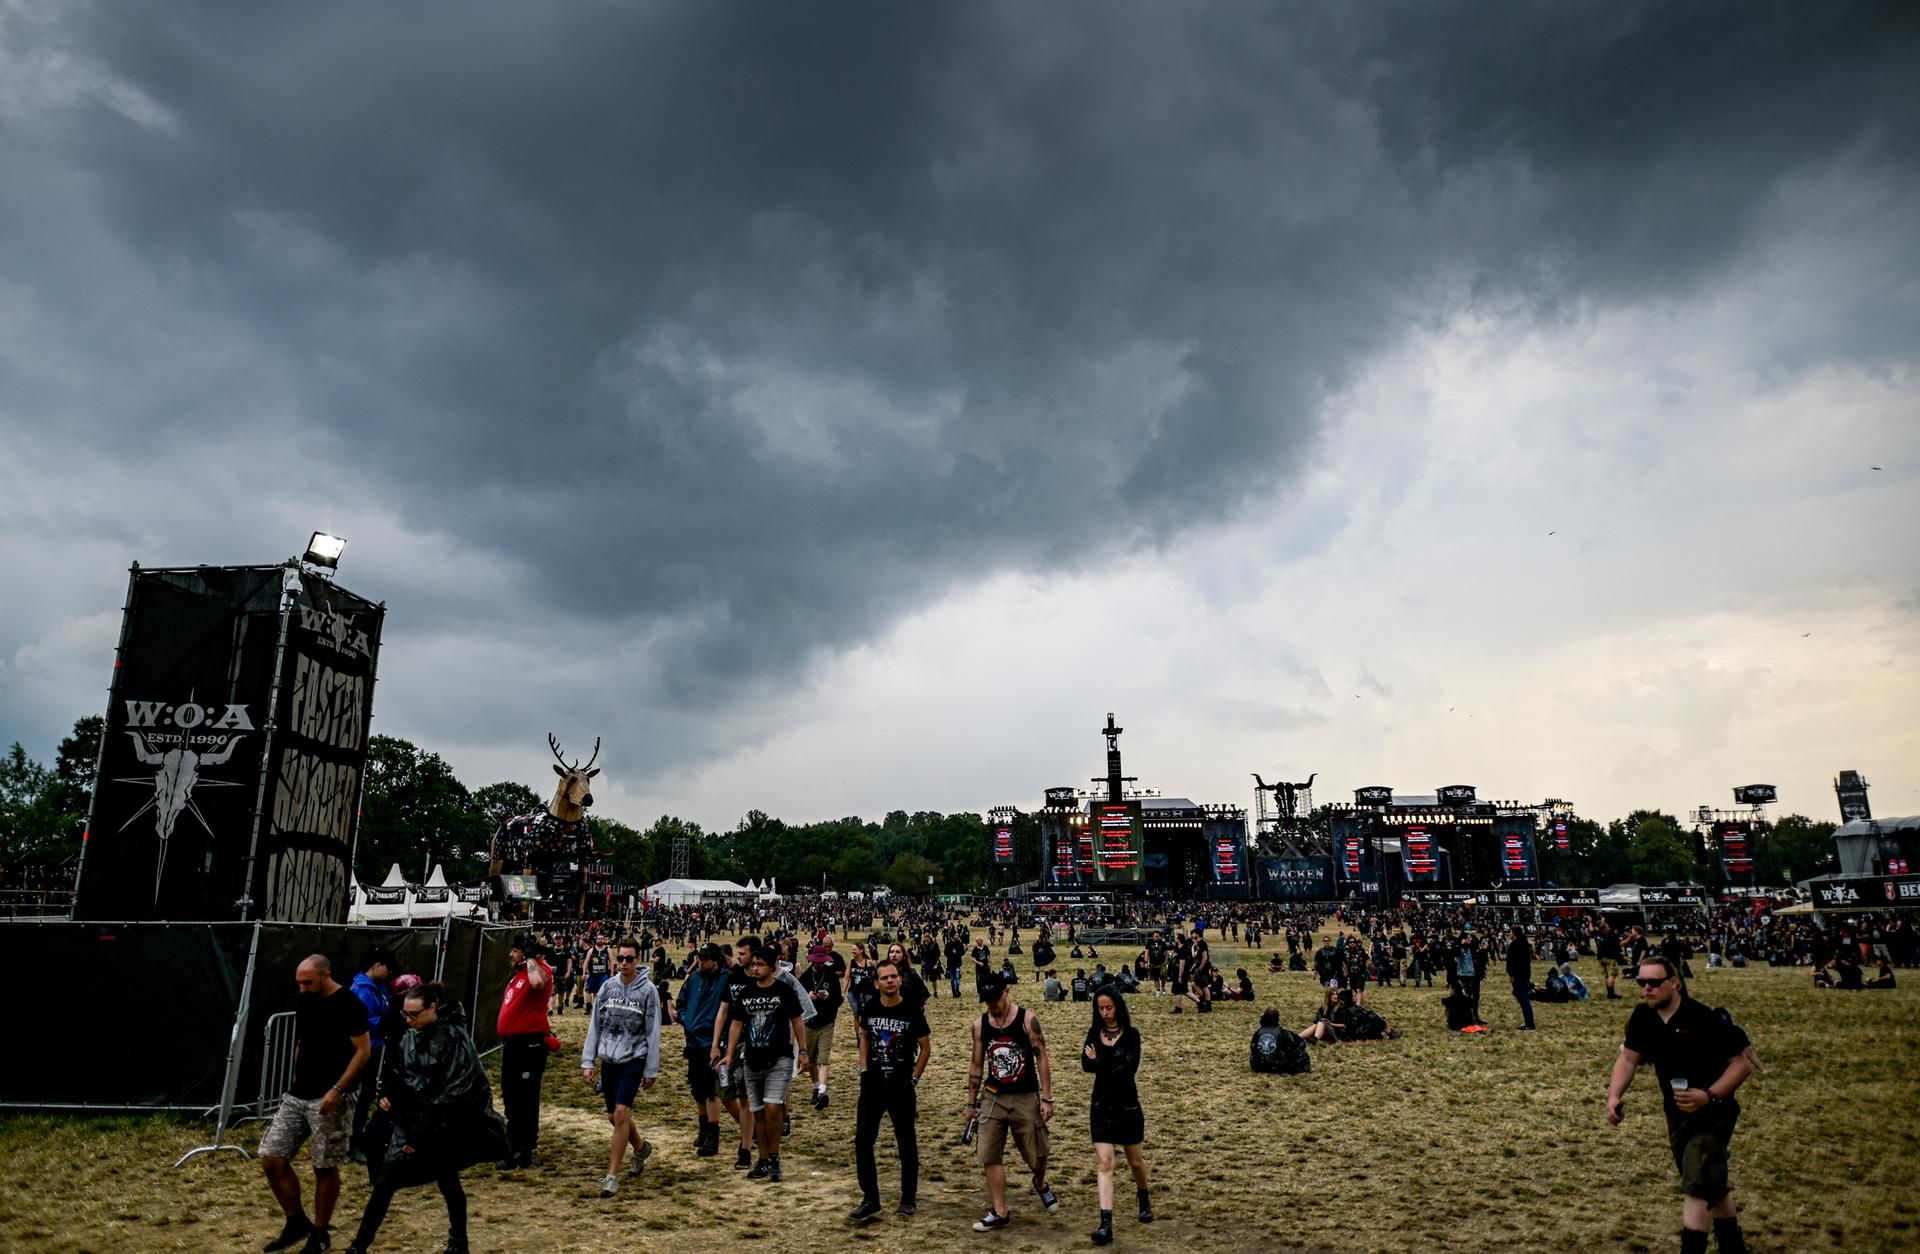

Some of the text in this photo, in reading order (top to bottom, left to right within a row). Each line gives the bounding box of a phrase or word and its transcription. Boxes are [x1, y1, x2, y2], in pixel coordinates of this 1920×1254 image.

[291, 651, 364, 750] FASTER
[189, 734, 228, 745] 1990
[270, 748, 357, 846] HARDER
[265, 847, 346, 925] LOUDER
[1267, 867, 1325, 880] WACKEN
[868, 1017, 911, 1030] METALFEST
